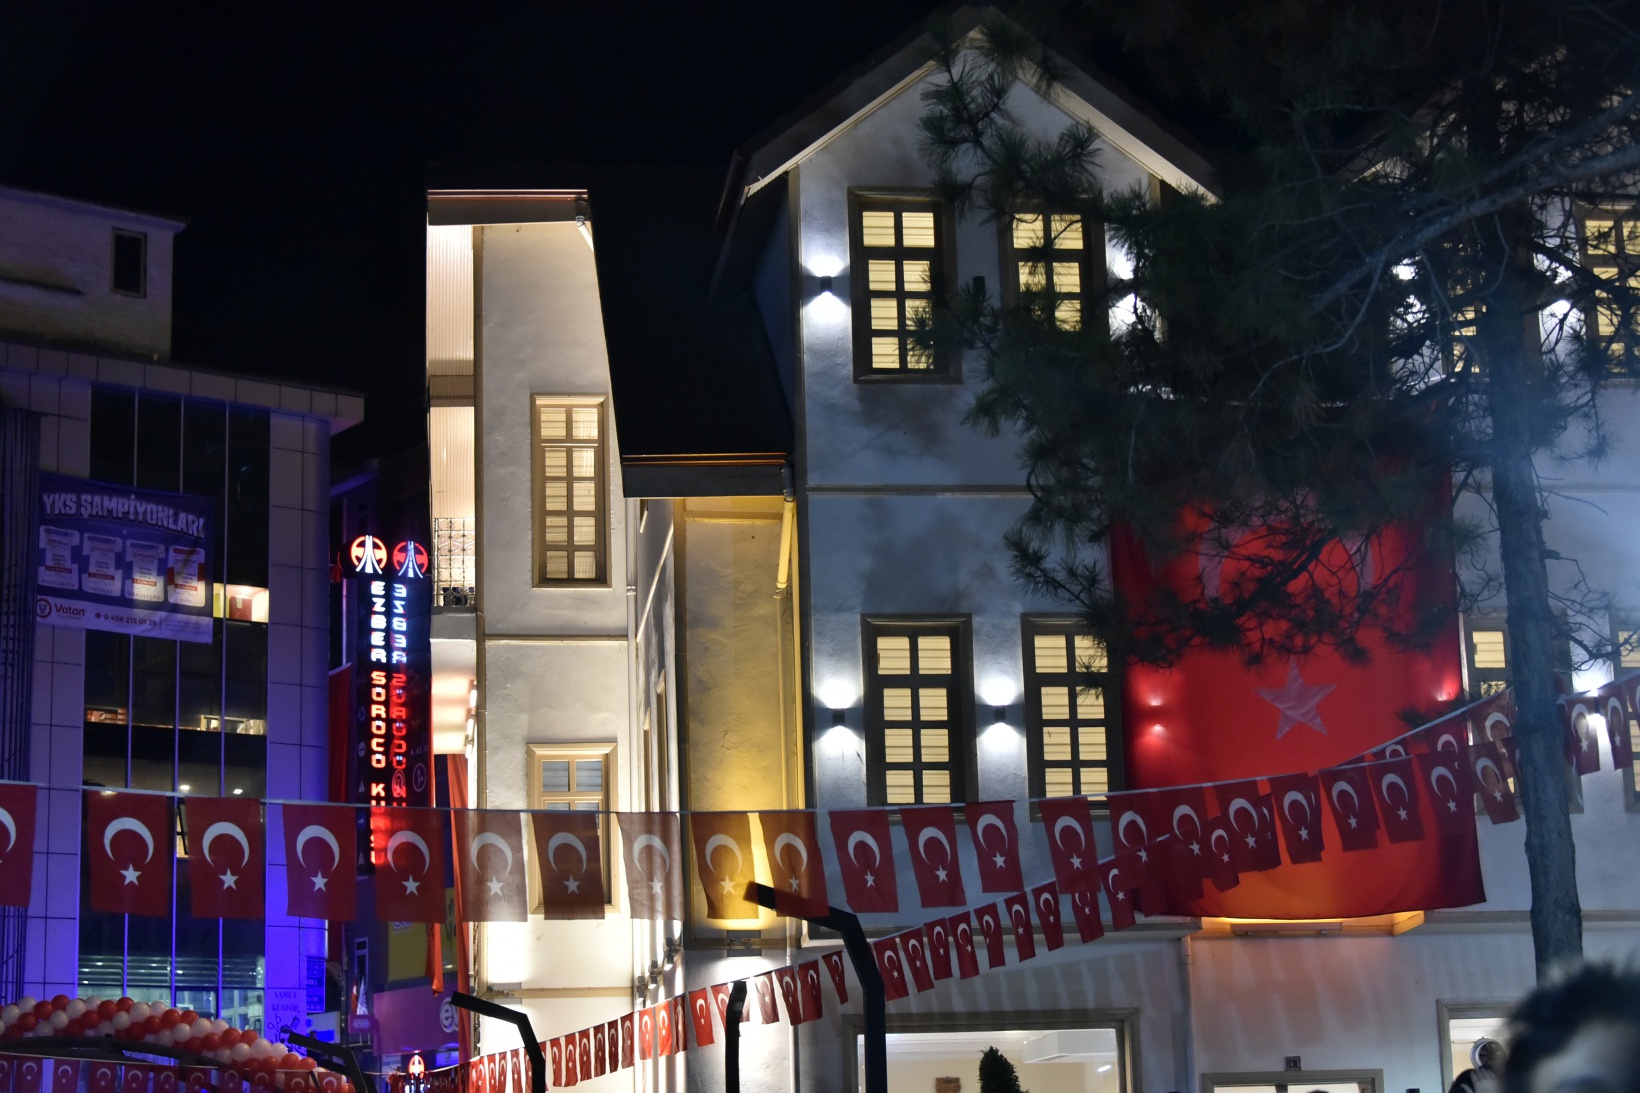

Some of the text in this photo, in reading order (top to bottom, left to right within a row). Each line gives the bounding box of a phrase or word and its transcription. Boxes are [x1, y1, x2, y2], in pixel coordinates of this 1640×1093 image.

[42, 494, 77, 515] YKS
[54, 603, 85, 616] Vatan
[371, 580, 387, 663] EZBER
